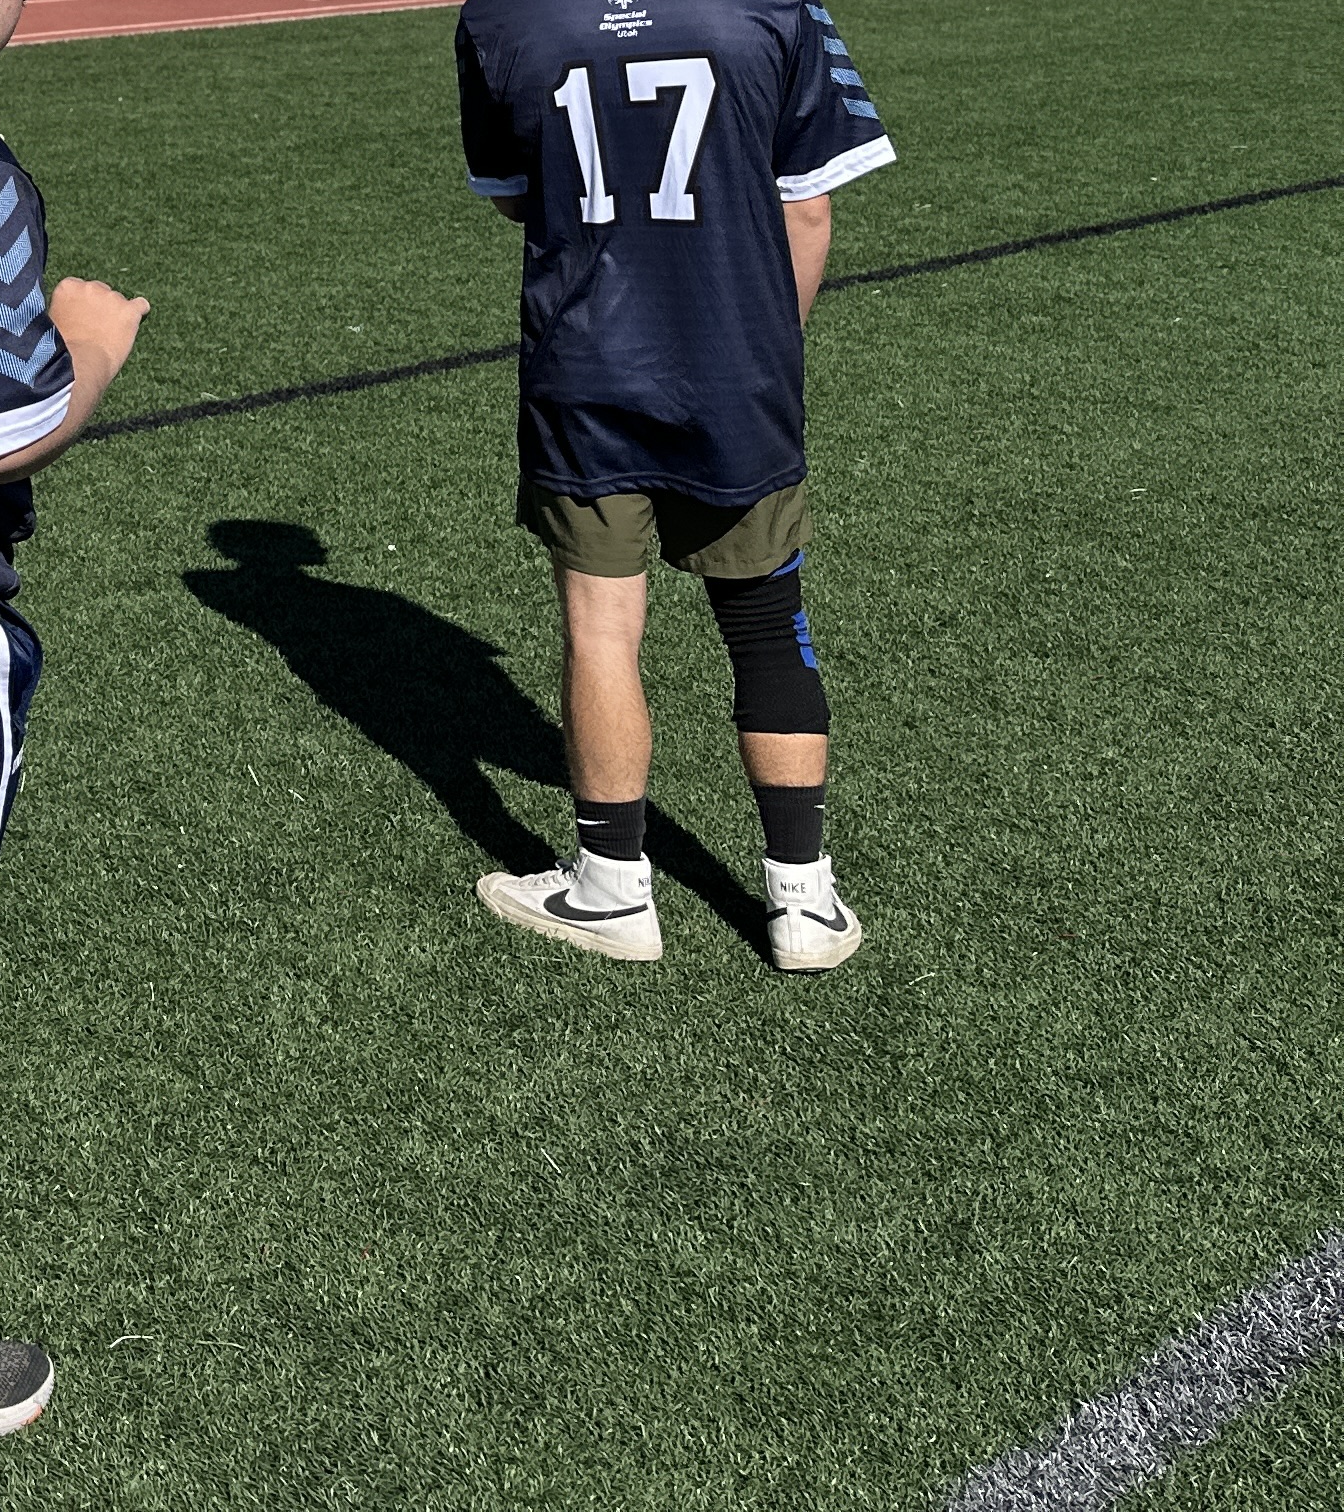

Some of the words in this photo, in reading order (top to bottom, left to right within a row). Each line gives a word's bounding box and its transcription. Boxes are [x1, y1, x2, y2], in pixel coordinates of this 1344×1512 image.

[603, 9, 647, 22] Special
[599, 19, 653, 31] Olympics
[616, 28, 638, 38] Utah
[548, 56, 718, 226] 17
[779, 881, 807, 894] NIKE
